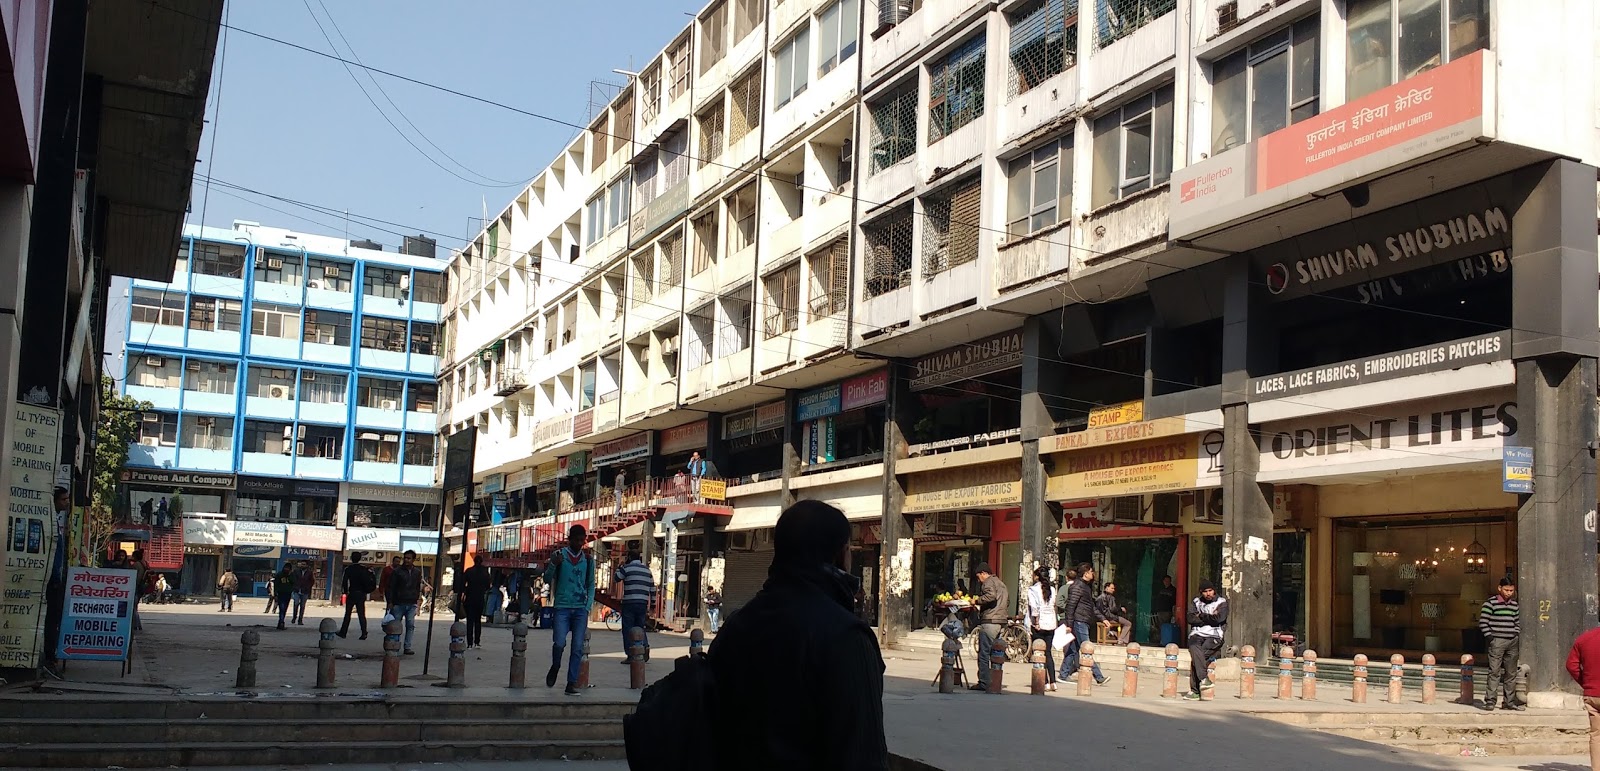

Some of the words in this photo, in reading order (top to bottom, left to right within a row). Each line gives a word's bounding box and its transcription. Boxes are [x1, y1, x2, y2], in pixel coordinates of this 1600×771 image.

[1306, 120, 1347, 150] फुलर्टन
[1351, 103, 1389, 130] इंडिया
[1395, 86, 1434, 112] क्रेडिट
[1305, 147, 1336, 164] FULLERTON
[1337, 141, 1353, 153] INDIA
[1354, 132, 1375, 147] CREDIT
[1376, 121, 1406, 139] COMPANY
[1407, 112, 1433, 127] LIMITED
[1196, 167, 1232, 186] Fullerton
[1196, 185, 1217, 198] India
[1296, 243, 1379, 284] SHIVAM
[1385, 207, 1508, 262] SHUBHAM
[916, 350, 961, 377] SHIVAM
[965, 333, 1023, 363] SHUBHA
[1255, 378, 1287, 394] LACES,
[1289, 372, 1313, 389] LACE
[1315, 364, 1360, 384] FABRICS,
[1364, 347, 1445, 376] EMBROIDERIES
[1449, 336, 1500, 360] PATCHES
[819, 388, 840, 402] FABRICS
[847, 382, 866, 400] Pink
[868, 377, 885, 394] Fab
[16, 410, 27, 422] LL
[29, 413, 56, 427] TYPES
[1089, 411, 1122, 426] STAMP
[25, 428, 36, 438] OF
[1055, 433, 1089, 449] PANKAJ
[1105, 422, 1154, 442] EXPORTS
[1271, 418, 1398, 460] ORIENT
[1408, 402, 1518, 447] LITES
[13, 441, 45, 455] MOBILE
[12, 457, 51, 471] EPAIRING
[1069, 454, 1115, 473] PANKAJ
[1120, 442, 1187, 466] EXPORTS
[1084, 473, 1089, 481] A
[1090, 470, 1114, 480] HOUSE
[1115, 469, 1124, 478] OF
[1124, 467, 1147, 477] EXPORT
[1148, 463, 1174, 473] FABRICS
[1512, 467, 1528, 475] VISA
[23, 474, 29, 483] &
[132, 471, 169, 482] Parveen
[171, 474, 190, 483] And
[192, 475, 233, 486] Company
[10, 486, 42, 500] MOBILE
[351, 487, 362, 495] THE
[365, 488, 399, 497] PRAKAASH
[401, 490, 439, 500] COLLECTION
[701, 485, 724, 494] STAMP
[915, 494, 921, 502] A
[922, 492, 941, 502] HOUSE
[944, 490, 952, 499] OF
[954, 487, 978, 499] EXPORT
[981, 483, 1012, 496] FABRICS
[236, 521, 261, 530] FASHION
[261, 522, 285, 531] FABRICS
[307, 529, 342, 540] FABRICS
[351, 531, 378, 545] KUKU
[300, 548, 320, 556] FABRI
[17, 557, 45, 569] TYPES
[12, 574, 24, 583] OF
[4, 589, 31, 599] OBILE
[70, 585, 130, 598] रिपेयरिंग
[2, 604, 34, 615] TTERY
[73, 603, 114, 615] RECHARGE
[1539, 600, 1551, 612] 27
[74, 620, 117, 632] MOBILE
[63, 634, 124, 647] REPAIRING
